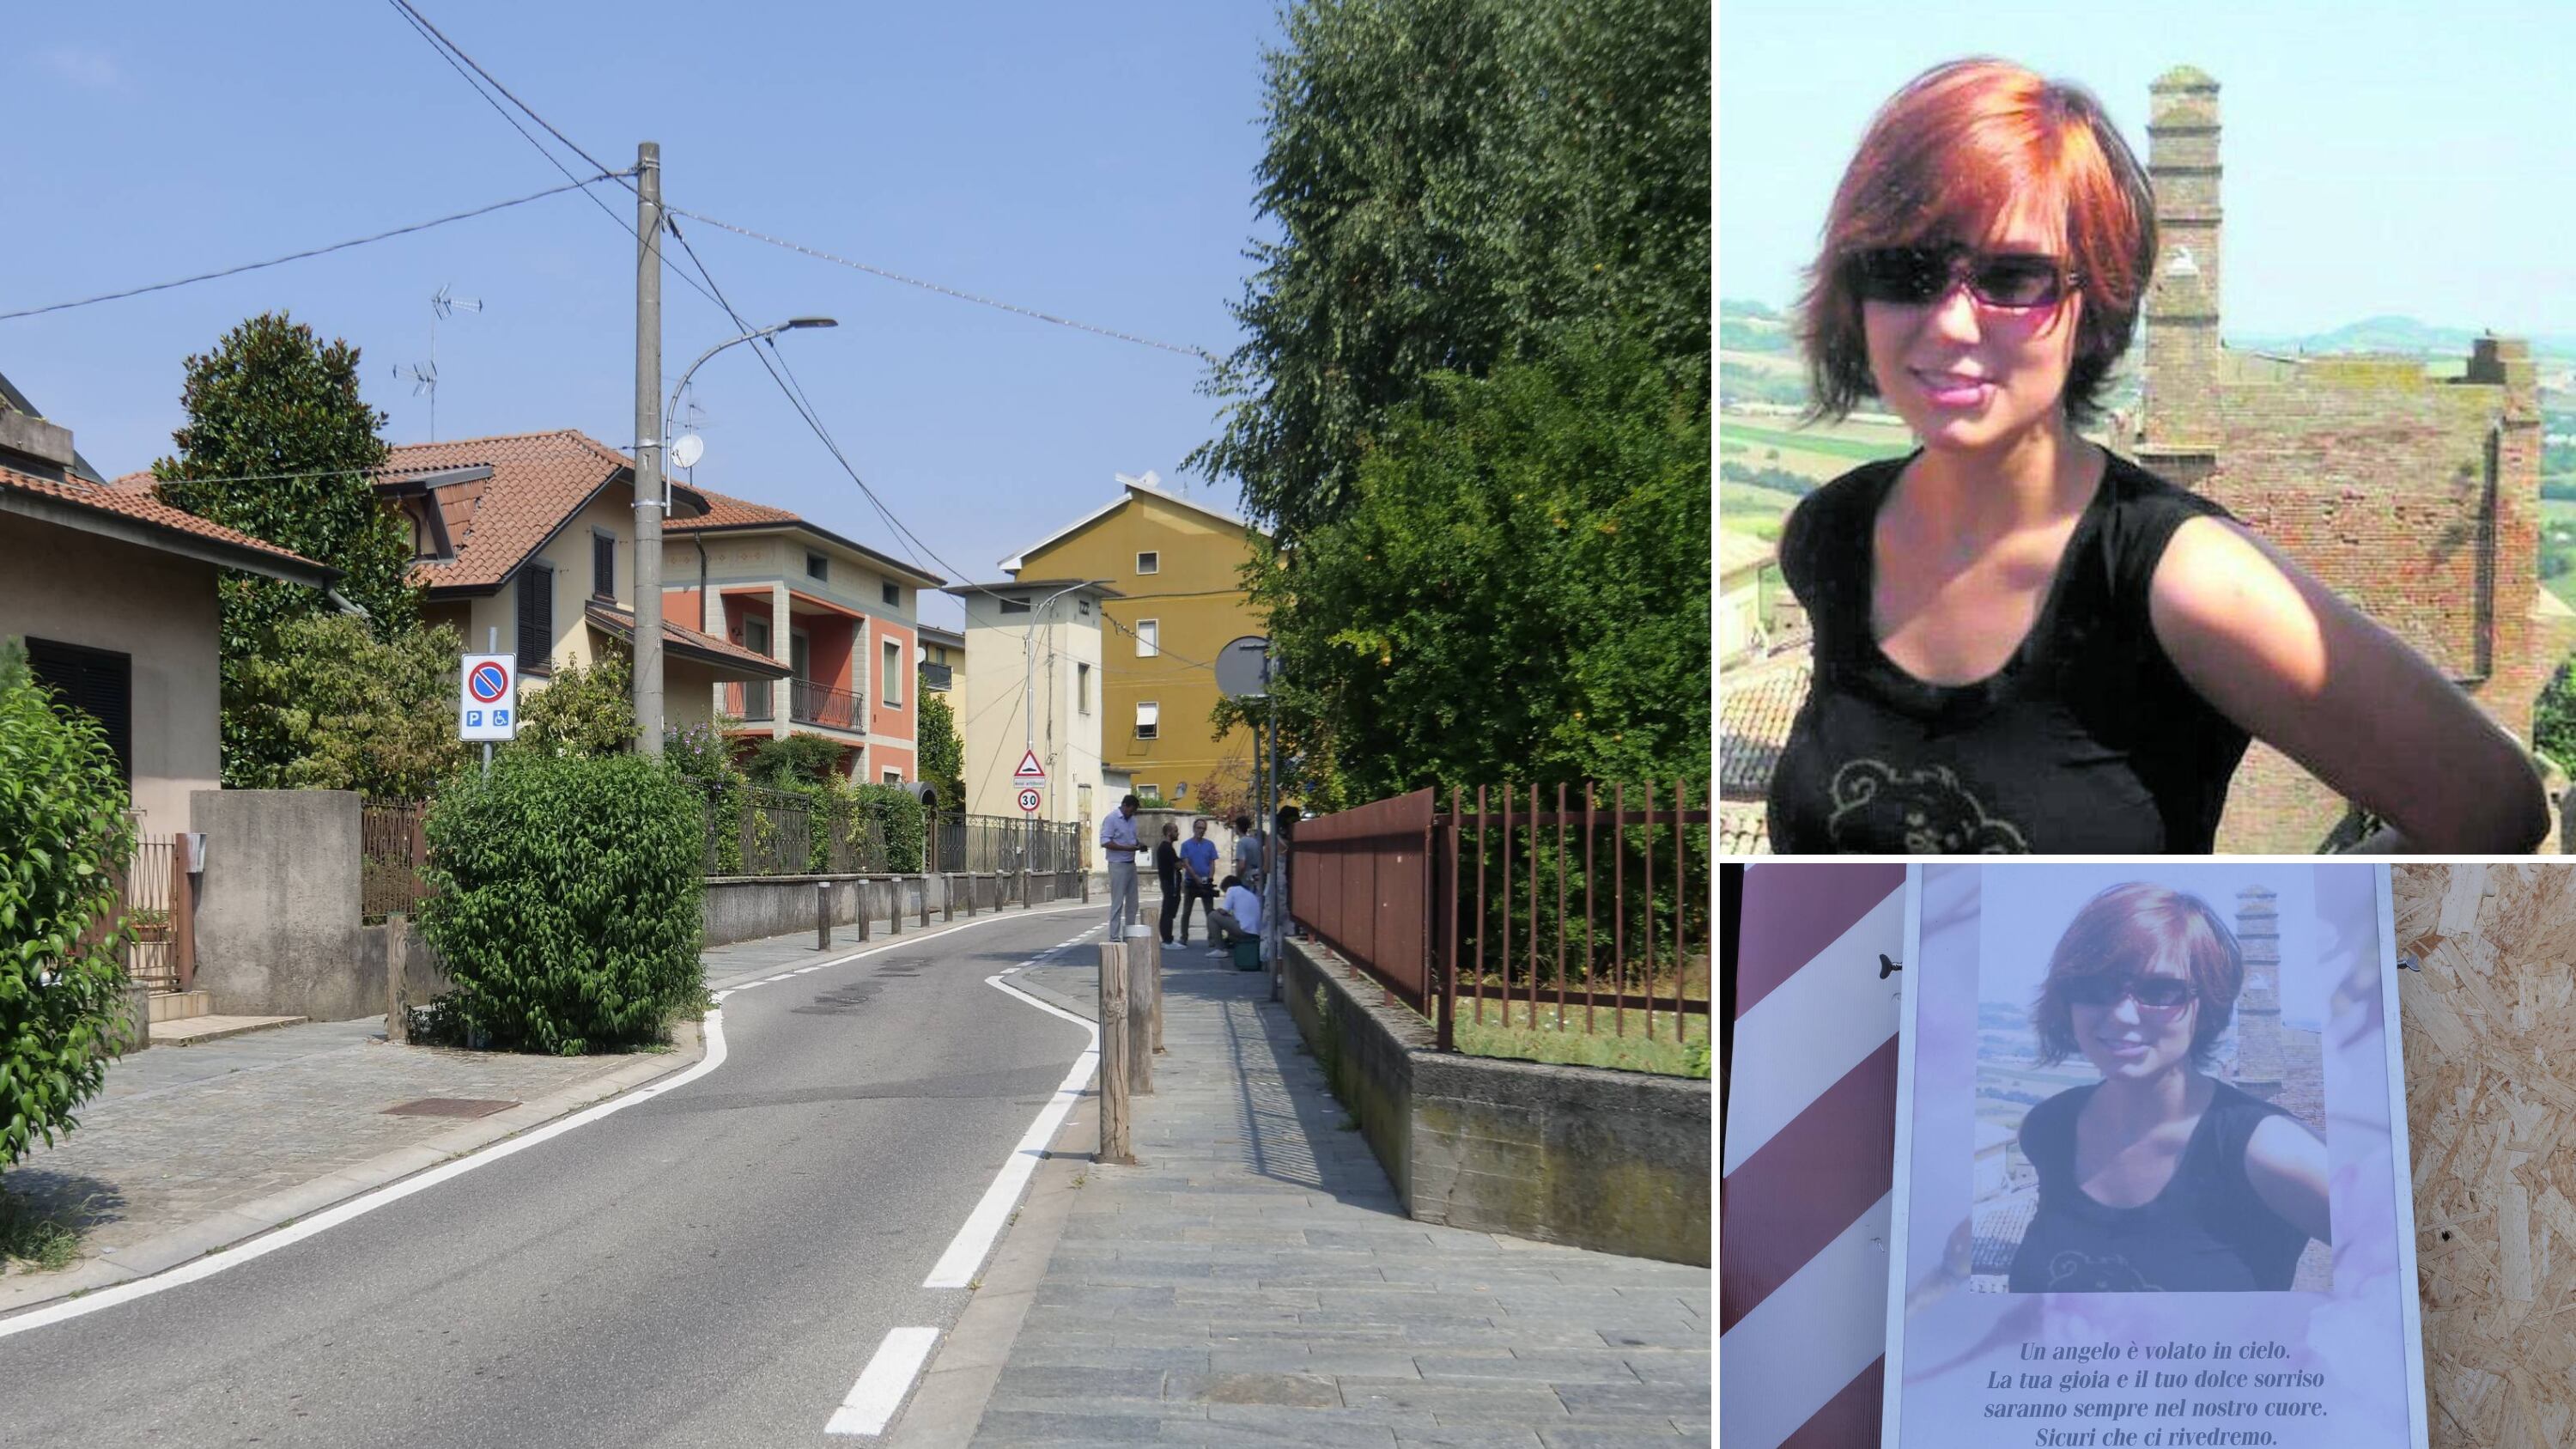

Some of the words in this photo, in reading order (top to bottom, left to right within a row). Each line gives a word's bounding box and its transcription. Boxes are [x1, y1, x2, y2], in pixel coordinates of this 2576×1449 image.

[469, 712, 479, 726] P
[1022, 795, 1036, 806] 30
[2020, 1342, 2046, 1361] Un
[2052, 1342, 2120, 1364] angelo
[2127, 1341, 2139, 1360] è
[2146, 1342, 2207, 1360] volato
[2212, 1342, 2232, 1360] in
[2239, 1341, 2290, 1360] cielo.
[1986, 1371, 2013, 1389] La
[2019, 1373, 2053, 1389] tua
[2059, 1370, 2110, 1393] gioia
[2117, 1374, 2129, 1388] e
[2135, 1370, 2148, 1388] il
[2154, 1372, 2188, 1388] tuo
[2194, 1370, 2248, 1388] dolce
[2254, 1369, 2325, 1388] sorriso
[1984, 1403, 2068, 1418] saranno
[2073, 1403, 2148, 1422] sempre
[2154, 1399, 2186, 1417] nel
[2191, 1399, 2258, 1417] nostro
[2264, 1402, 2327, 1416] cuore.
[2035, 1428, 2096, 1447] Sicuri
[2102, 1428, 2138, 1446] che
[2144, 1428, 2162, 1446] ci
[2167, 1428, 2278, 1446] rivedremo.
